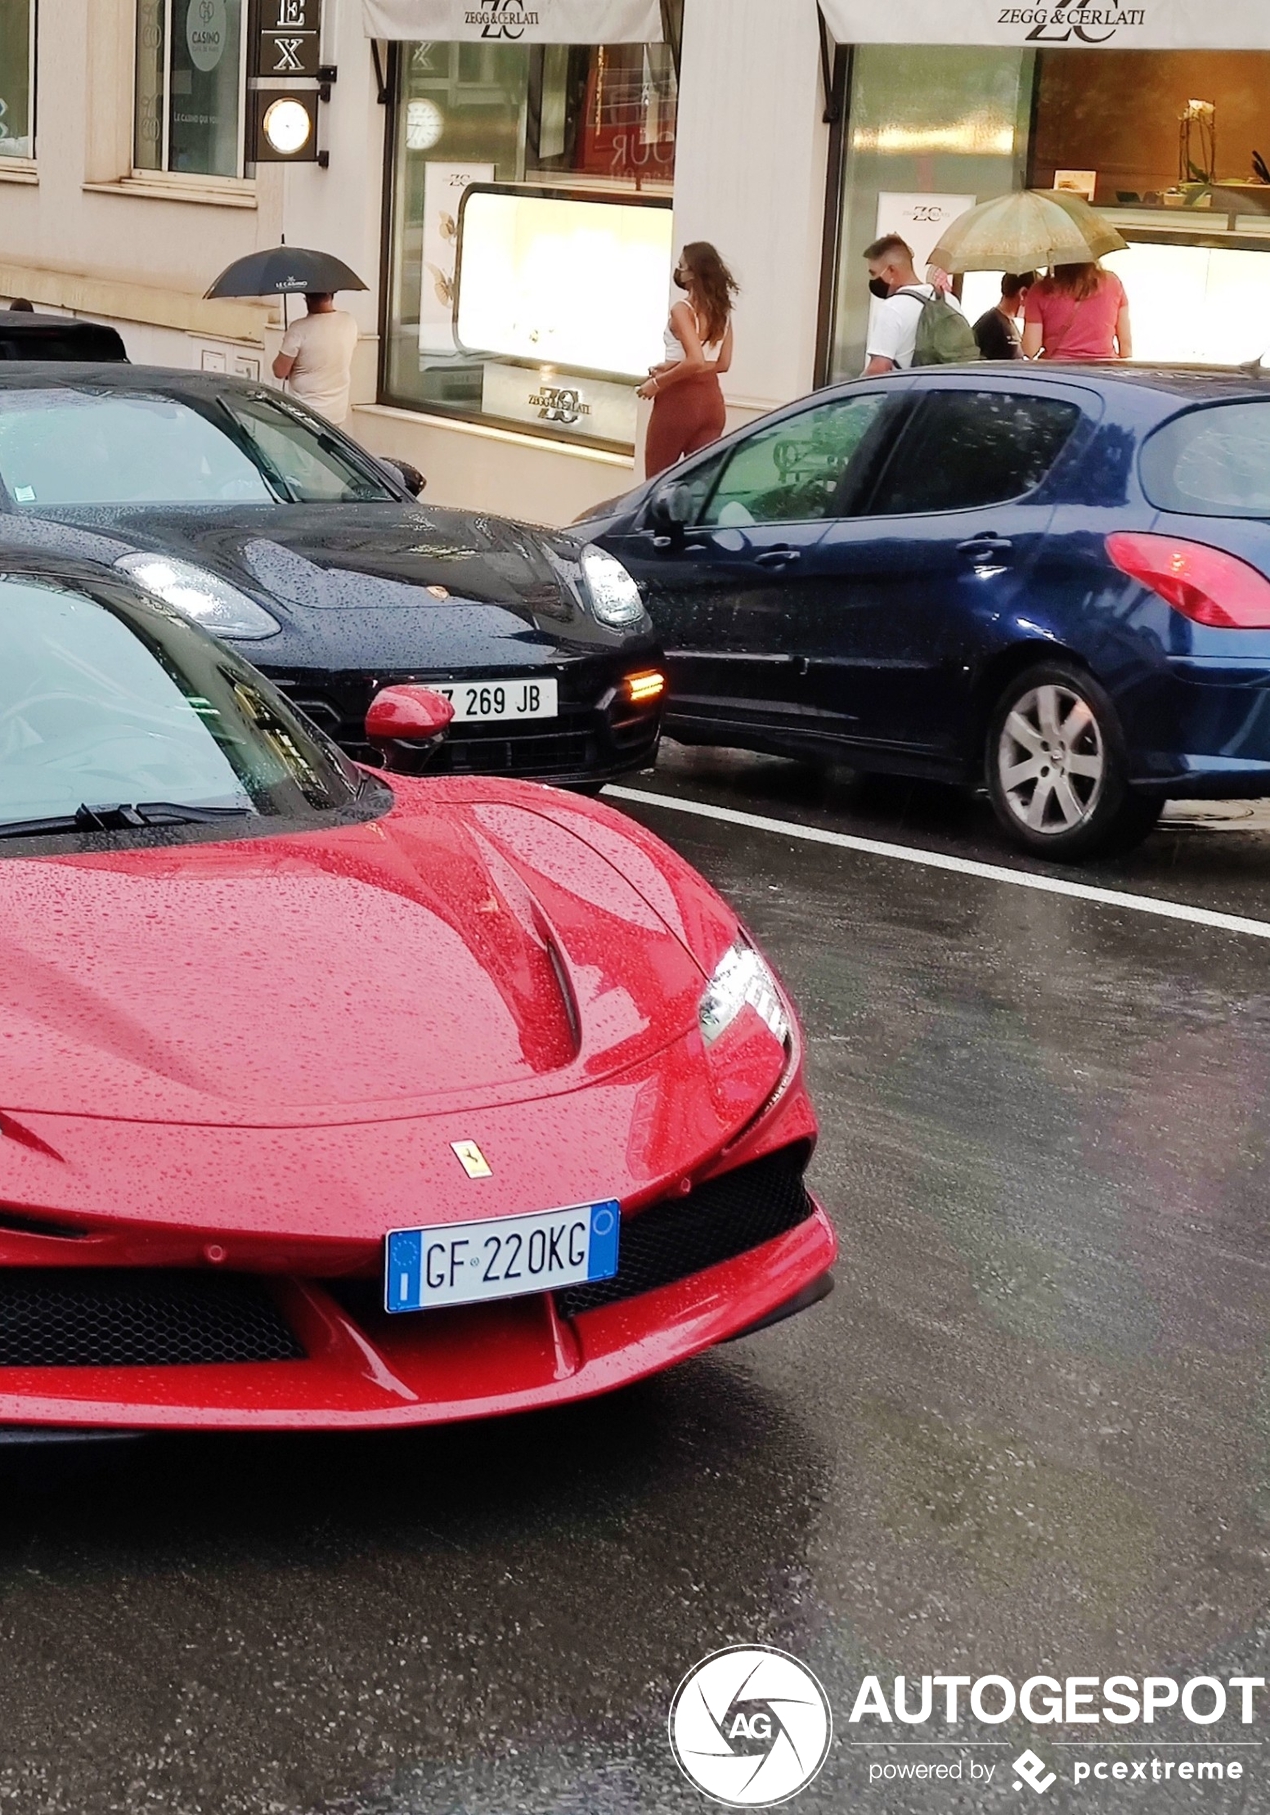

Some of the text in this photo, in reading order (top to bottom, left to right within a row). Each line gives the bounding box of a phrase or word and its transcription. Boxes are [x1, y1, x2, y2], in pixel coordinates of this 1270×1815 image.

[192, 31, 220, 44] CASINO
[466, 688, 505, 716] 269
[516, 685, 540, 713] JB
